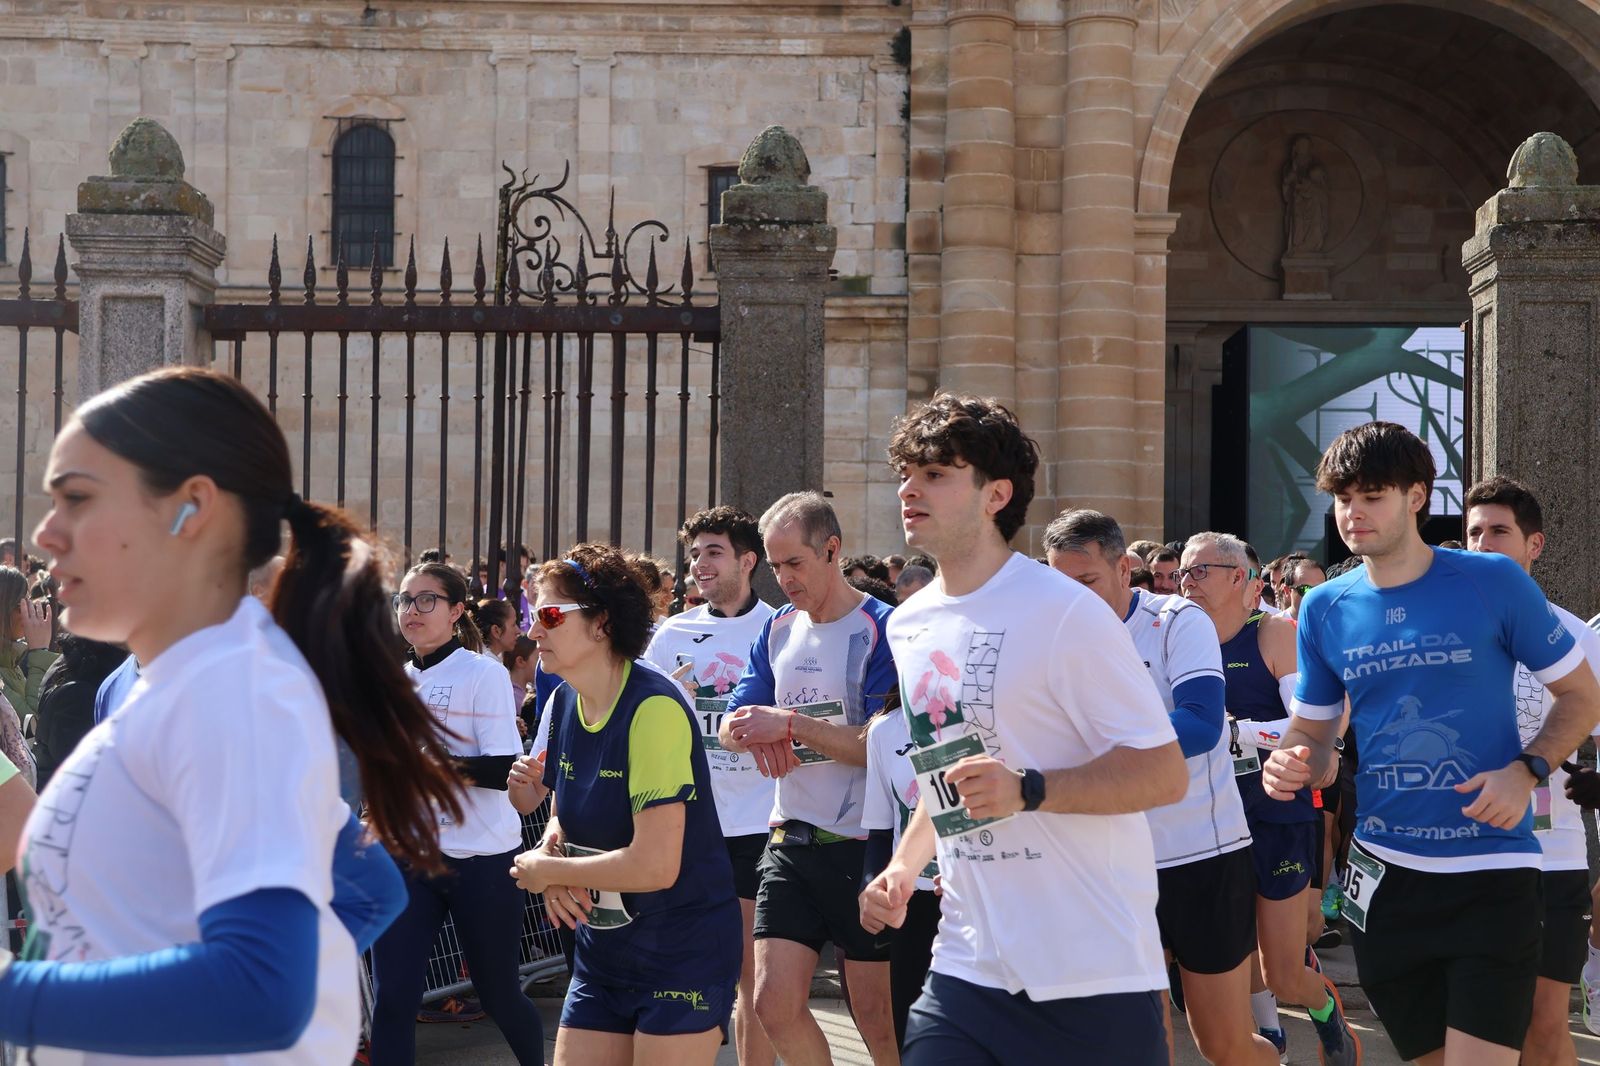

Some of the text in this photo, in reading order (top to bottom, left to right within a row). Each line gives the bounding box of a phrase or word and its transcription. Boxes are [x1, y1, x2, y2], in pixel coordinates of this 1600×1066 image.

[1342, 632, 1463, 662] TRAIL DA
[1343, 648, 1473, 681] AMIZADE
[1366, 760, 1470, 791] TDA
[1393, 822, 1480, 840] campet
